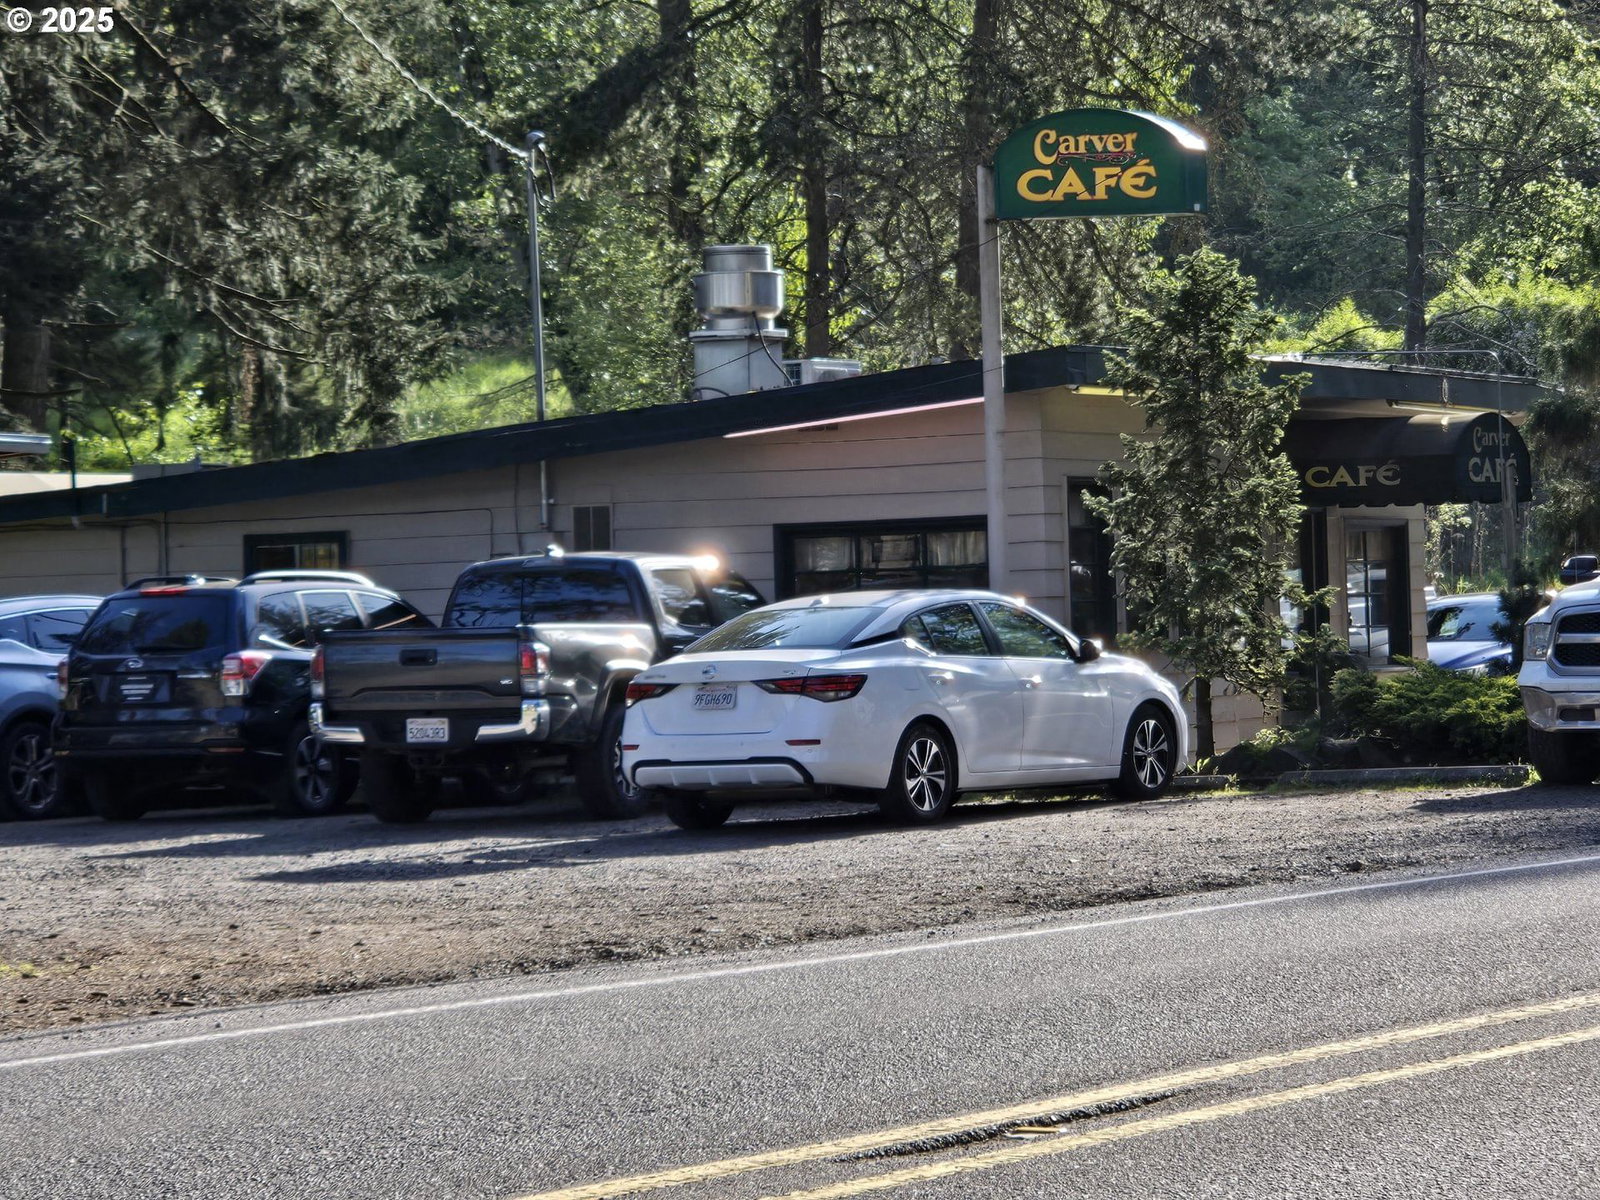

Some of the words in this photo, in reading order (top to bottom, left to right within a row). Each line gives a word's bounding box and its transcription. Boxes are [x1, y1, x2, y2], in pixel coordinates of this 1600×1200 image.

[1034, 129, 1138, 165] Carver
[1016, 159, 1157, 202] CAFÉ
[1305, 459, 1401, 488] CAFÉ
[694, 693, 733, 706] 9FGH690
